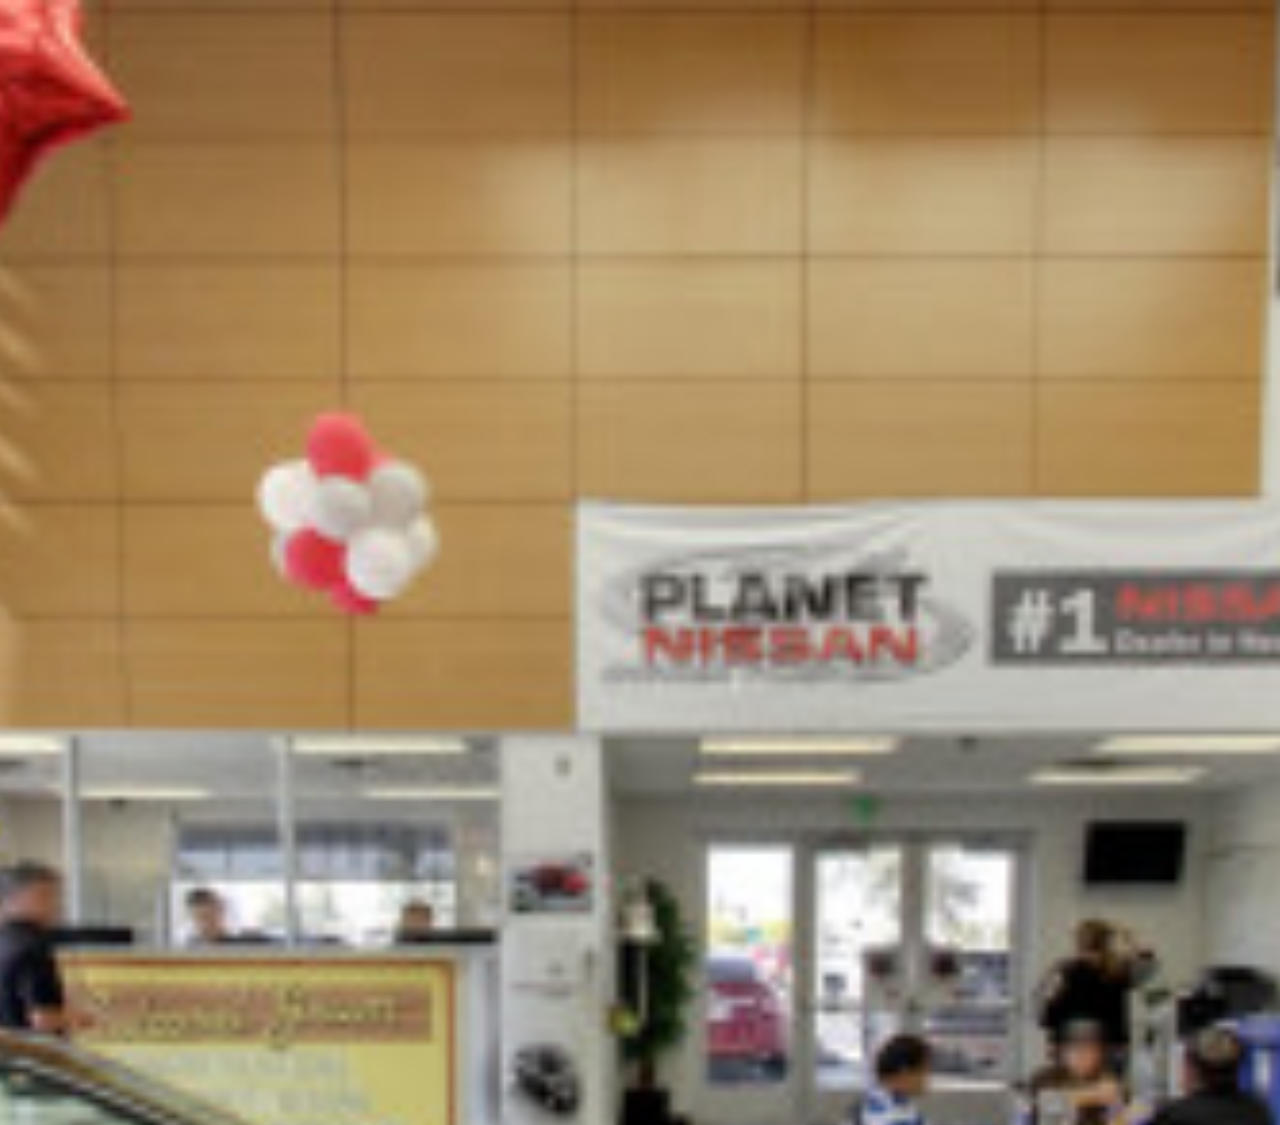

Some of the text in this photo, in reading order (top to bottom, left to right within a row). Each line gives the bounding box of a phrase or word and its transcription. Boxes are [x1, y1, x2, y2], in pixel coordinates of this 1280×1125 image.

[638, 573, 928, 621] PLANET
[1005, 587, 1108, 654] #1
[642, 625, 920, 668] NISSAN
